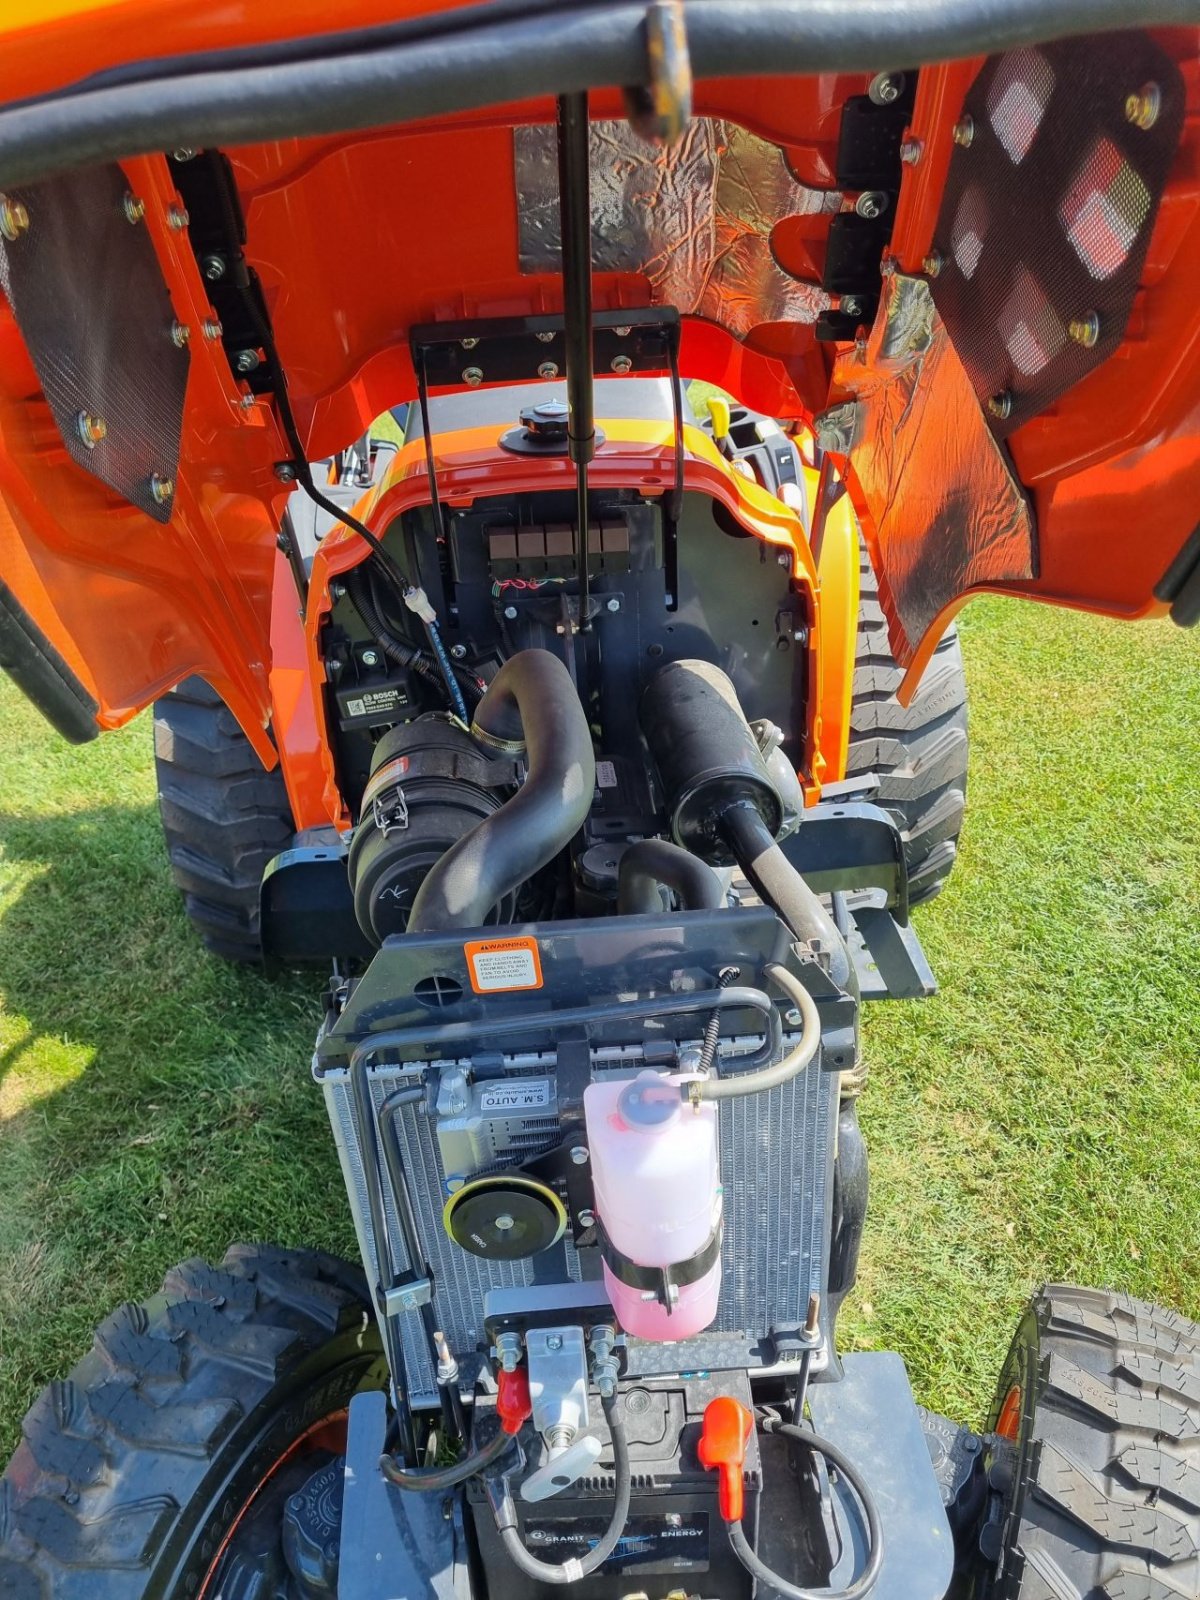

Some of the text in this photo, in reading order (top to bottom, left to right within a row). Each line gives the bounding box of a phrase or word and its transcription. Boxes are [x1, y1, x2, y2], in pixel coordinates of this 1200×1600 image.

[373, 690, 398, 700] BOSCH
[489, 941, 528, 949] WARNING
[487, 1096, 518, 1106] AUTO
[661, 1529, 703, 1537] ENERGY
